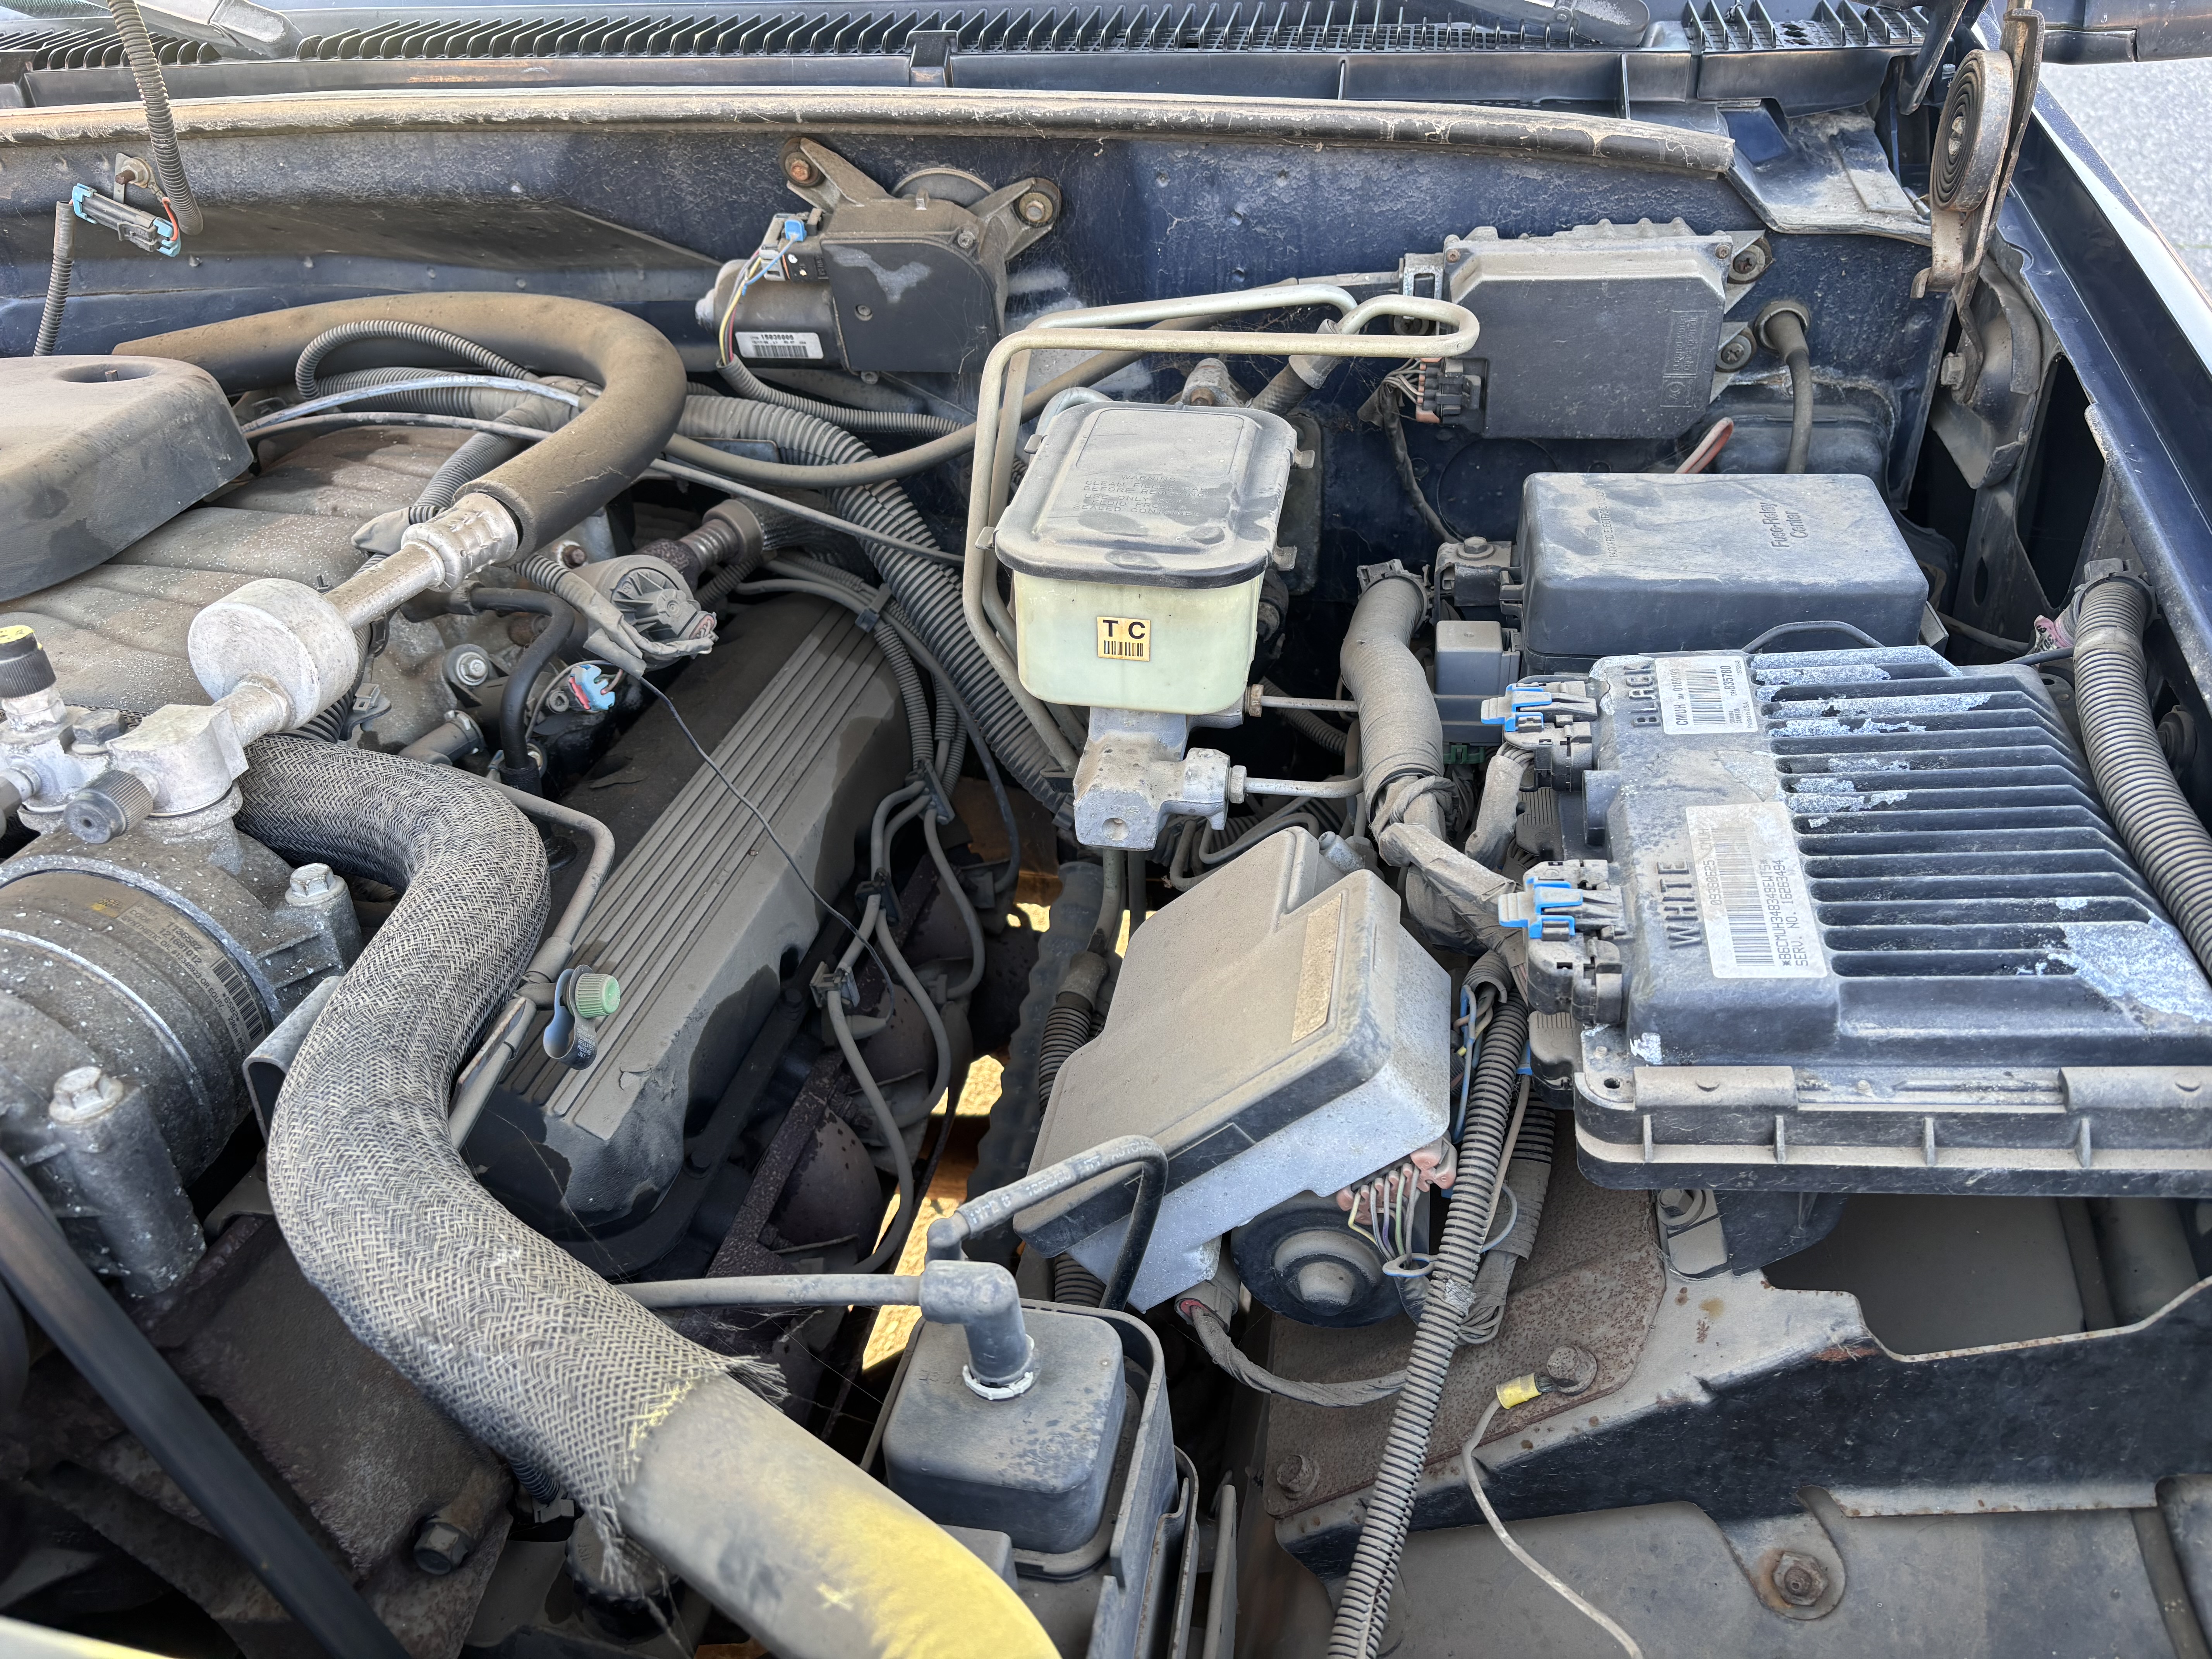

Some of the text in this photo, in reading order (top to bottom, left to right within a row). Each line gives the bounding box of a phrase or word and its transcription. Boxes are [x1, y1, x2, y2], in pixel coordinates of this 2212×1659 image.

[1140, 489, 1205, 498] REMOVING
[1131, 508, 1202, 517] CONTAINER
[1599, 509, 1613, 534] ELECTRIC
[1759, 502, 1790, 547] Fuse-Relay
[1785, 511, 1808, 538] Center
[1604, 534, 1619, 558] PACKARD
[1102, 620, 1146, 639] T C
[1669, 669, 1683, 691] 0169193
[1623, 664, 1661, 727] BLACK
[1674, 704, 1689, 725] CMUH
[1697, 828, 1722, 906] 09380625 CMUH
[129, 909, 151, 925] CODE
[1656, 861, 1702, 950] WHITE
[1772, 859, 1808, 966] SERV. NO. 16263494
[158, 927, 202, 966] 121681012
[166, 921, 203, 951] 1136582
[121, 915, 162, 942] SYNTHETIC
[160, 938, 172, 951] OIL
[171, 949, 202, 979] #12345923
[201, 976, 210, 989] OR
[208, 987, 225, 1011] EQUIV.
